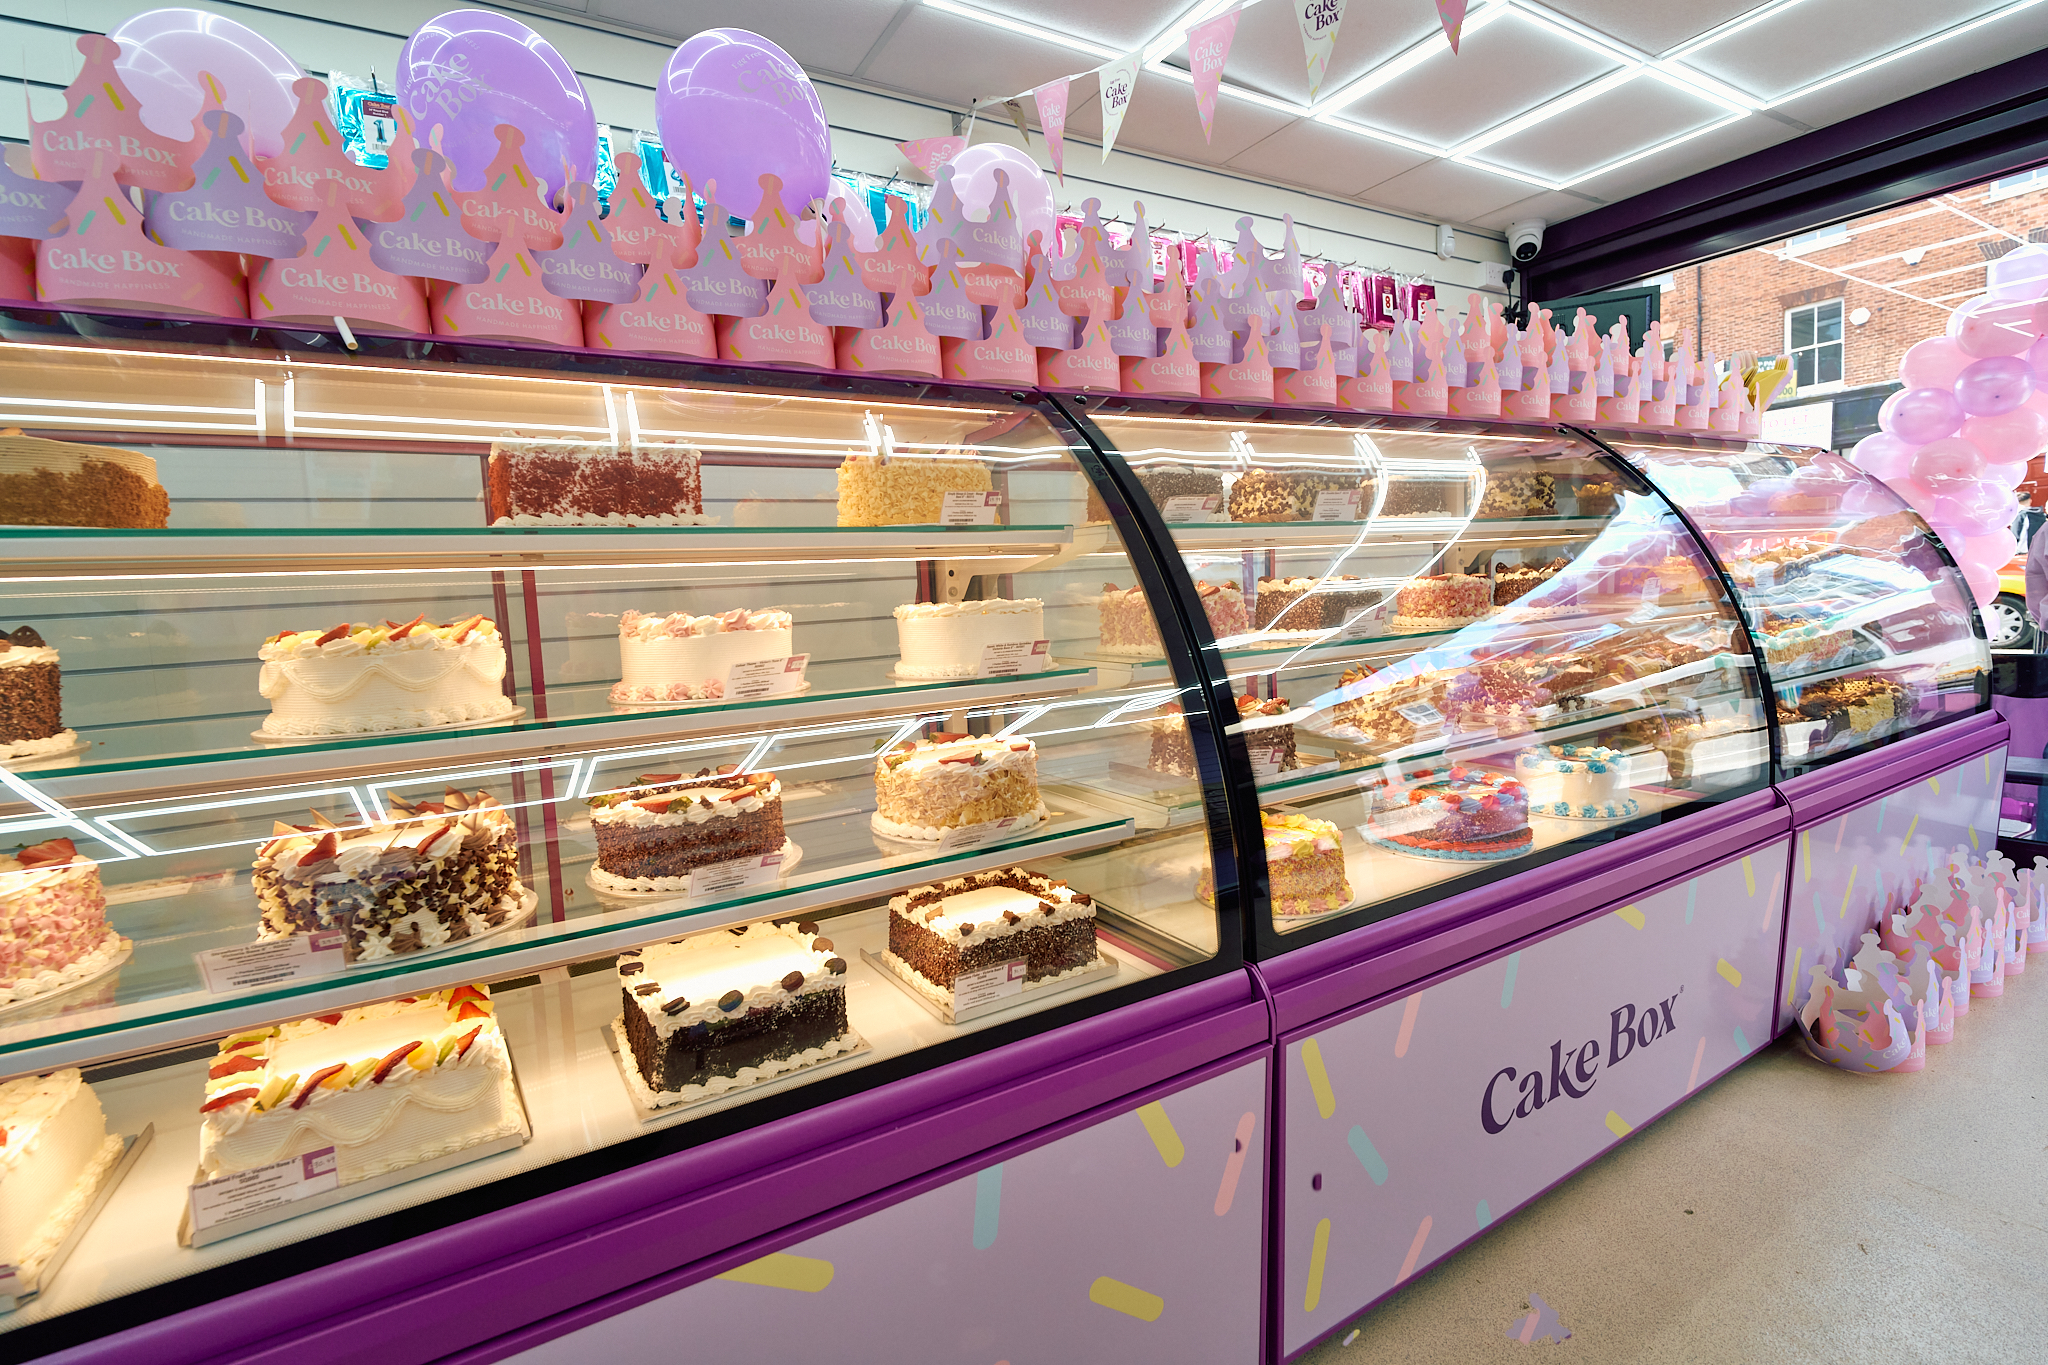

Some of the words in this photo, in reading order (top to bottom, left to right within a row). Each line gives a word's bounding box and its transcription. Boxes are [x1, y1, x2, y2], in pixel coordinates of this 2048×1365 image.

[1316, 10, 1340, 31] Box
[1194, 42, 1223, 61] Cake
[1202, 56, 1224, 73] Box
[410, 54, 472, 120] Cake
[1106, 82, 1128, 98] Cake
[1042, 103, 1060, 117] Cake
[1112, 95, 1128, 108] Box
[1048, 116, 1062, 128] Box
[119, 135, 178, 168] Box
[264, 166, 320, 188] Cake
[170, 201, 240, 228] Cake
[244, 206, 296, 236] Box
[523, 207, 558, 234] Box
[181, 228, 234, 242] HANDMADE
[237, 237, 288, 246] HAPPINESS
[973, 228, 1008, 250] Cake
[379, 230, 442, 257] Cake
[446, 238, 485, 265] Box
[48, 248, 116, 274] Cake
[121, 250, 181, 278] Box
[390, 254, 437, 270] HANDMADE
[440, 264, 478, 274] HAPPINESS
[1100, 256, 1125, 269] Box
[541, 258, 596, 281] Cake
[599, 262, 632, 286] Box
[59, 277, 110, 290] HANDMADE
[114, 279, 170, 290] HAPPINESS
[281, 268, 349, 294] Cake
[352, 273, 398, 300] Box
[551, 280, 592, 292] HANDMADE
[730, 278, 759, 300] Box
[292, 294, 343, 308] HANDMADE
[346, 300, 391, 310] HAPPINESS
[466, 292, 524, 316] Cake
[528, 296, 563, 321] Box
[806, 290, 850, 309] Cake
[852, 292, 877, 312] Box
[1228, 302, 1258, 315] Cake
[1385, 296, 1391, 308] 8
[956, 304, 978, 324] Box
[1304, 315, 1335, 328] Cake
[476, 316, 520, 328] HANDMADE
[522, 323, 558, 331] HAPPINESS
[620, 311, 671, 332] Cake
[674, 315, 704, 336] Box
[1021, 315, 1048, 332] ake
[1050, 317, 1070, 334] Box
[628, 333, 667, 344] HANDMADE
[669, 338, 700, 346] HAPPINESS
[750, 324, 796, 344] Cake
[798, 326, 825, 346] Box
[1108, 326, 1141, 342] Cake
[1190, 334, 1215, 349] ake
[758, 344, 792, 354] HANDMADE
[870, 336, 912, 354] Cake
[914, 337, 937, 355] Box
[1266, 340, 1295, 355] Cake
[878, 354, 909, 364] HANDMADE
[974, 346, 1013, 364] Cake
[1016, 348, 1034, 365] Box
[1066, 355, 1102, 372] Cake
[1151, 363, 1184, 378] Cake
[1229, 369, 1260, 384] Cake
[1304, 376, 1329, 390] Cake
[1358, 382, 1385, 394] Cake
[1416, 388, 1442, 399] Cake
[1467, 392, 1493, 403] Cake
[1521, 395, 1545, 406] Cake
[1883, 1038, 1906, 1059] Cake
[1481, 1039, 1600, 1134] Cake
[252, 1164, 275, 1175] Victoria
